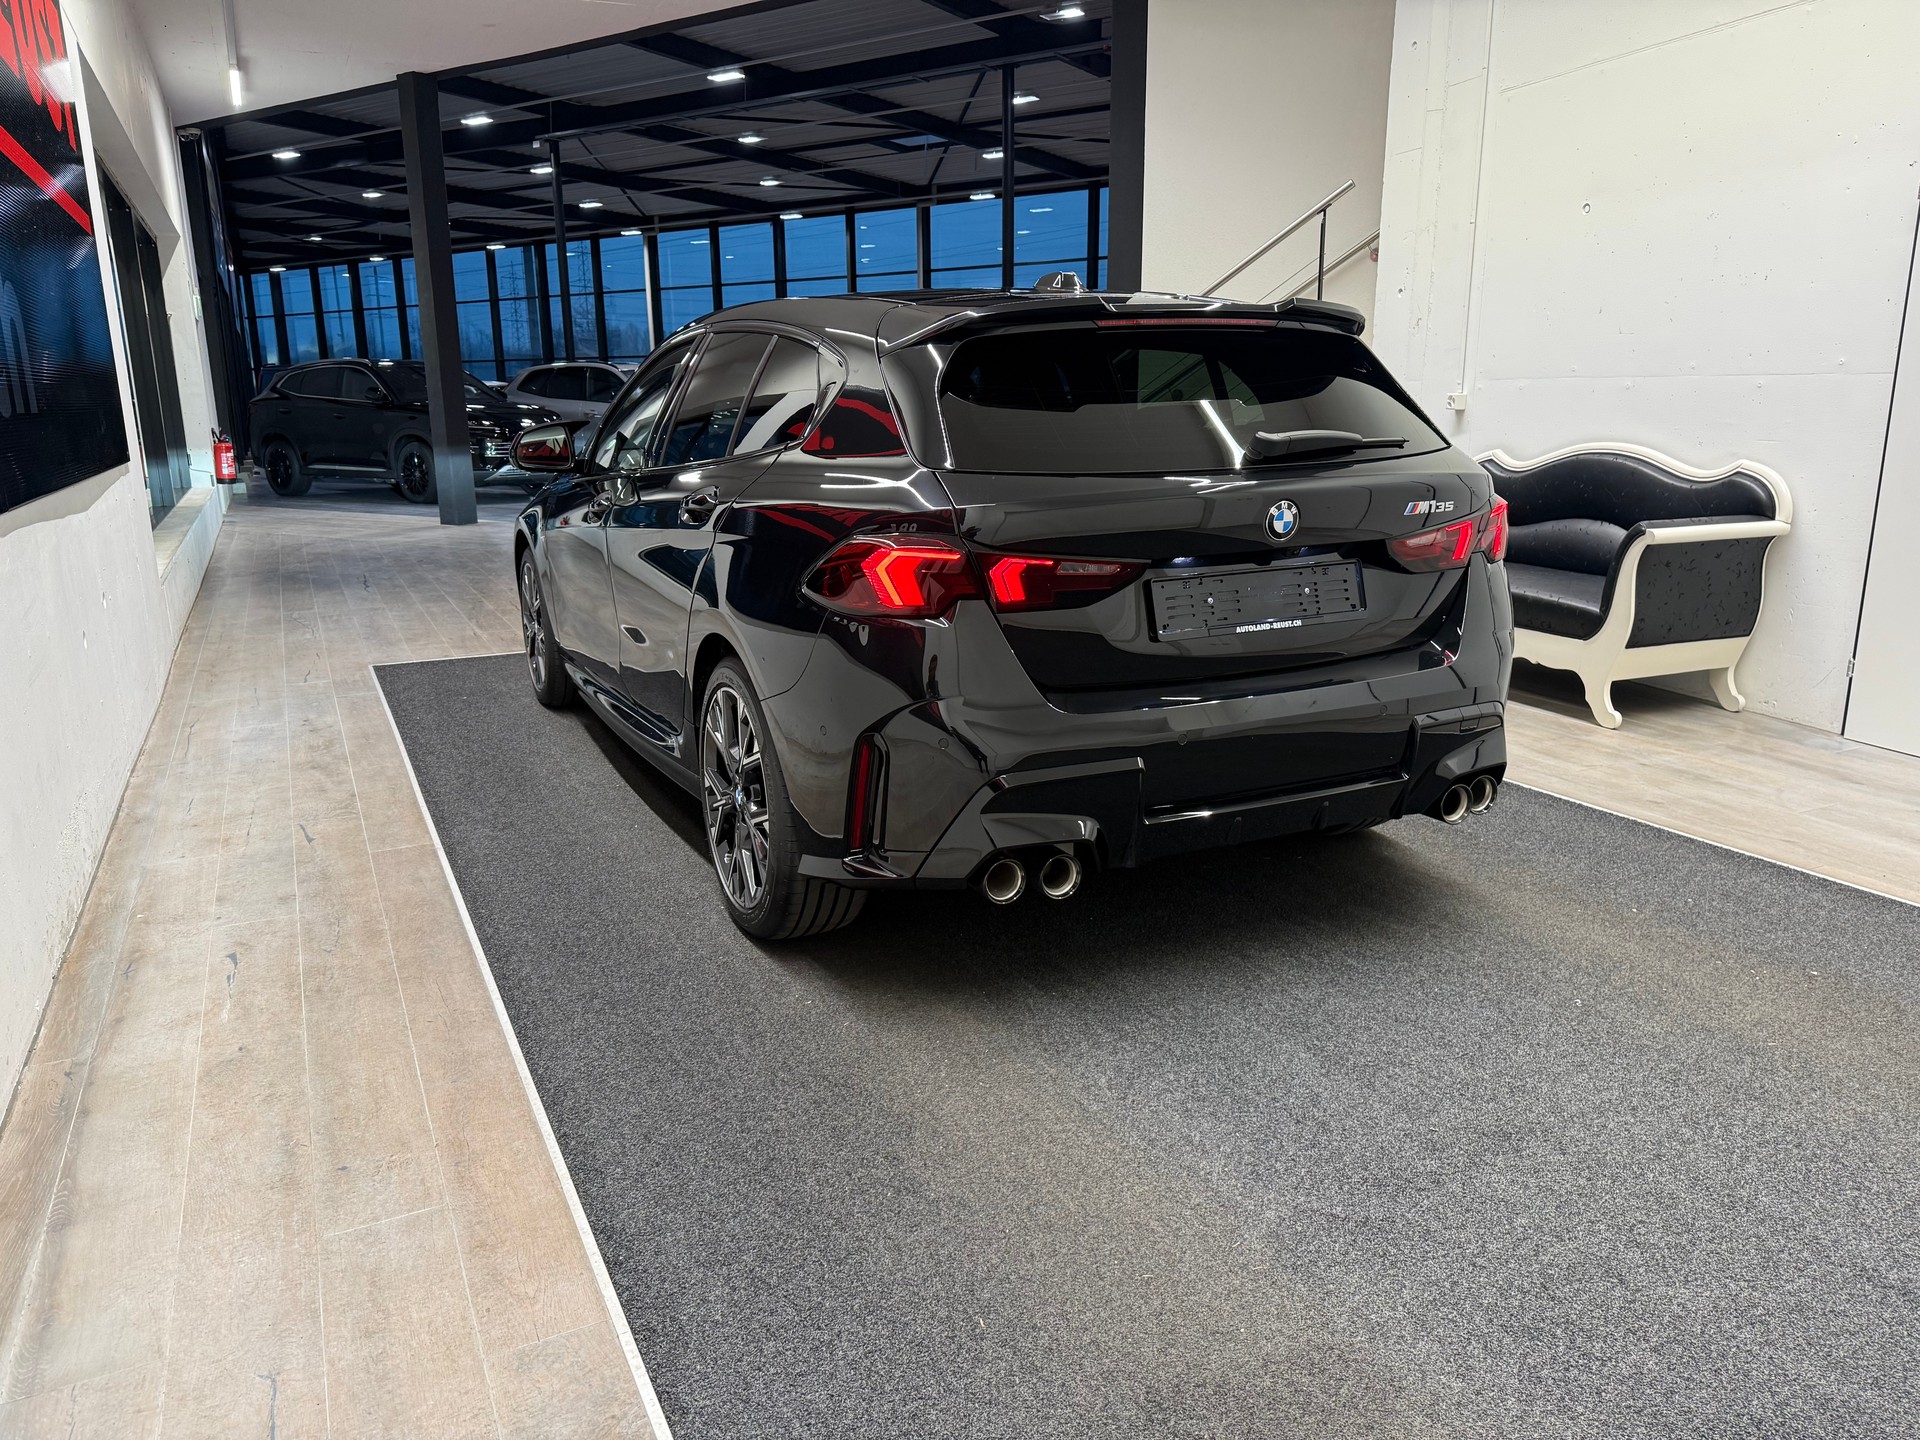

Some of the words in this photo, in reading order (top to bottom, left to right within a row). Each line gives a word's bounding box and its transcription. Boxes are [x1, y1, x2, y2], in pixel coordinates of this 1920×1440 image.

[1270, 502, 1298, 516] BMW
[1416, 500, 1454, 514] M135
[1235, 619, 1302, 633] AUTOLAND-REUST.CH
